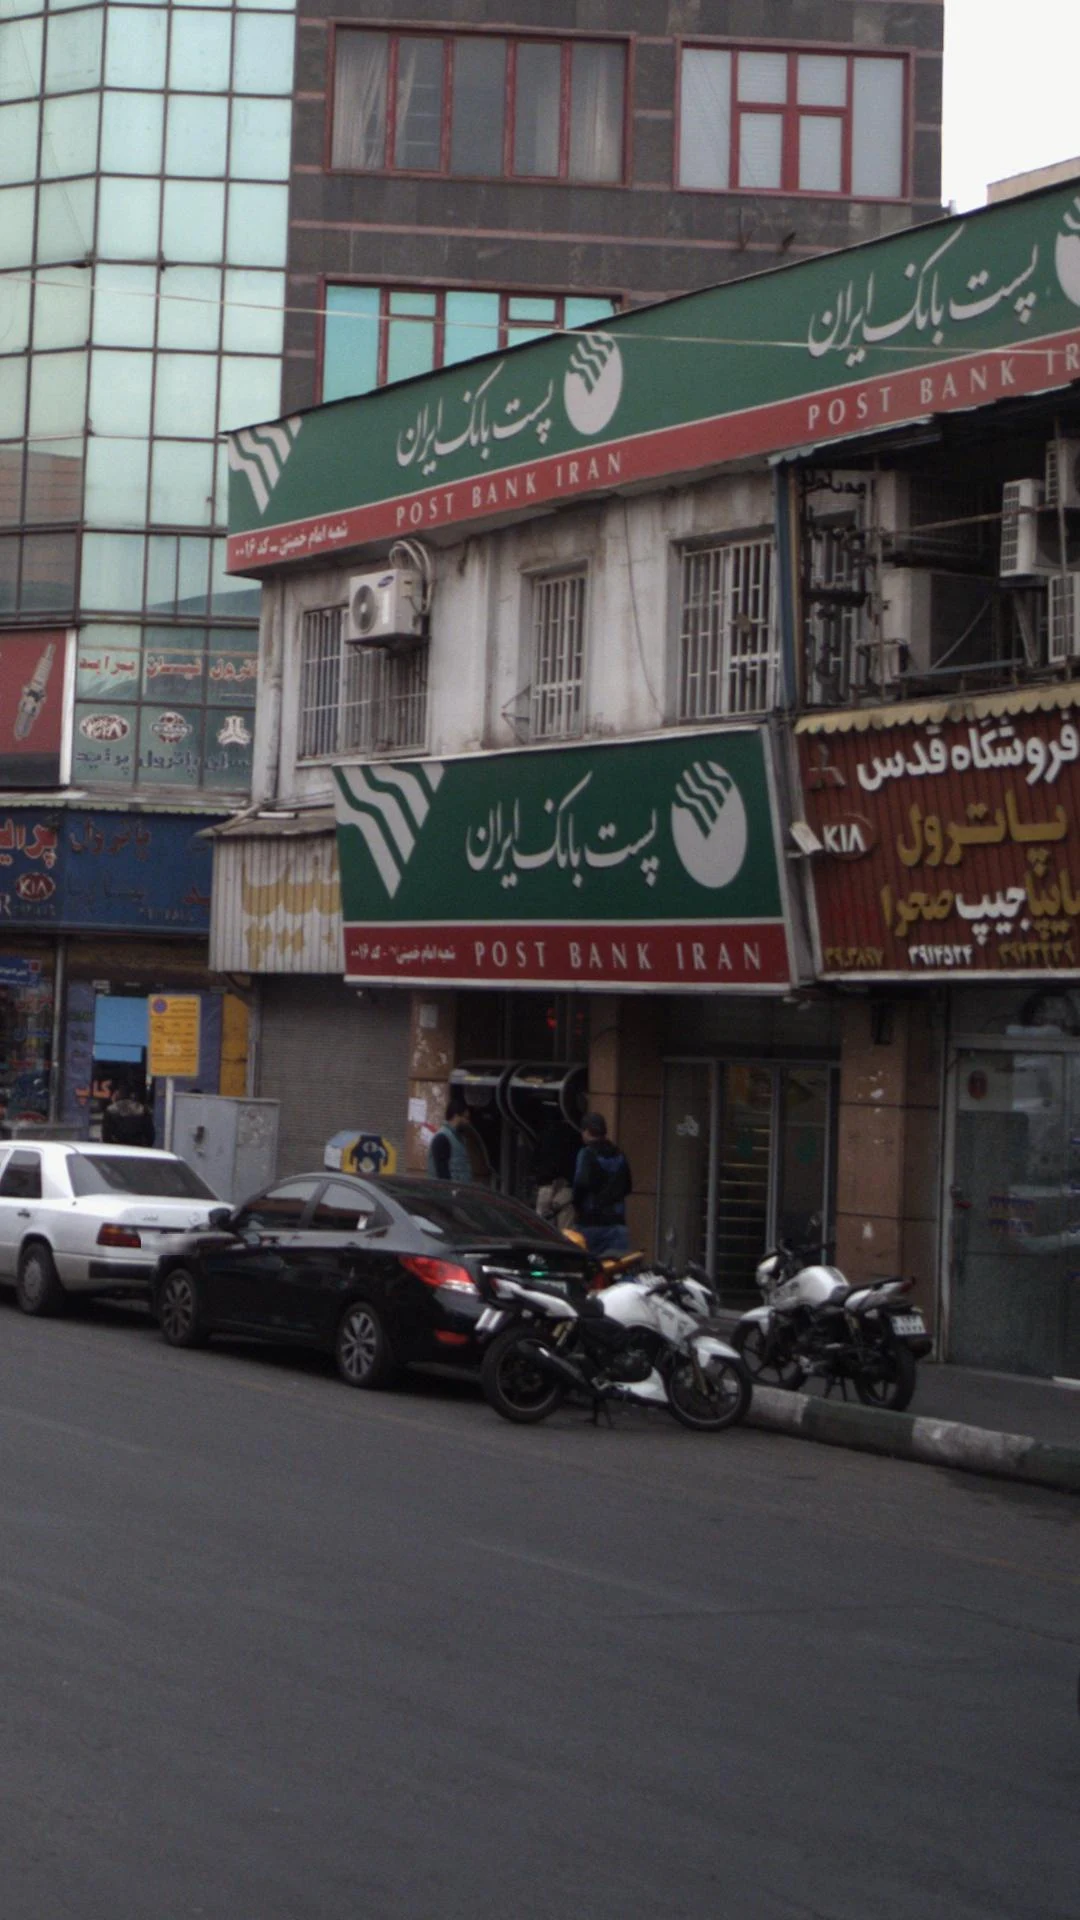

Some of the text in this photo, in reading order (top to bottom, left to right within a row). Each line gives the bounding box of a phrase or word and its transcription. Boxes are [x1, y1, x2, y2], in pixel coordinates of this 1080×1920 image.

[807, 223, 1039, 367] پست بانک ایران
[394, 360, 556, 478] پست بانک ایران
[807, 387, 892, 430] POST
[920, 357, 1017, 405] BANK
[395, 451, 623, 528] POST BANK IRAN
[857, 711, 1080, 792] فروشگاه قدس
[465, 770, 658, 889] پست بانک ایران
[823, 823, 867, 853] KIA
[896, 788, 1068, 875] پاترول
[18, 878, 50, 897] KIA
[880, 885, 955, 937] صحرا
[955, 886, 1031, 946] جیپ
[475, 941, 761, 971] POST BANK IRAN
